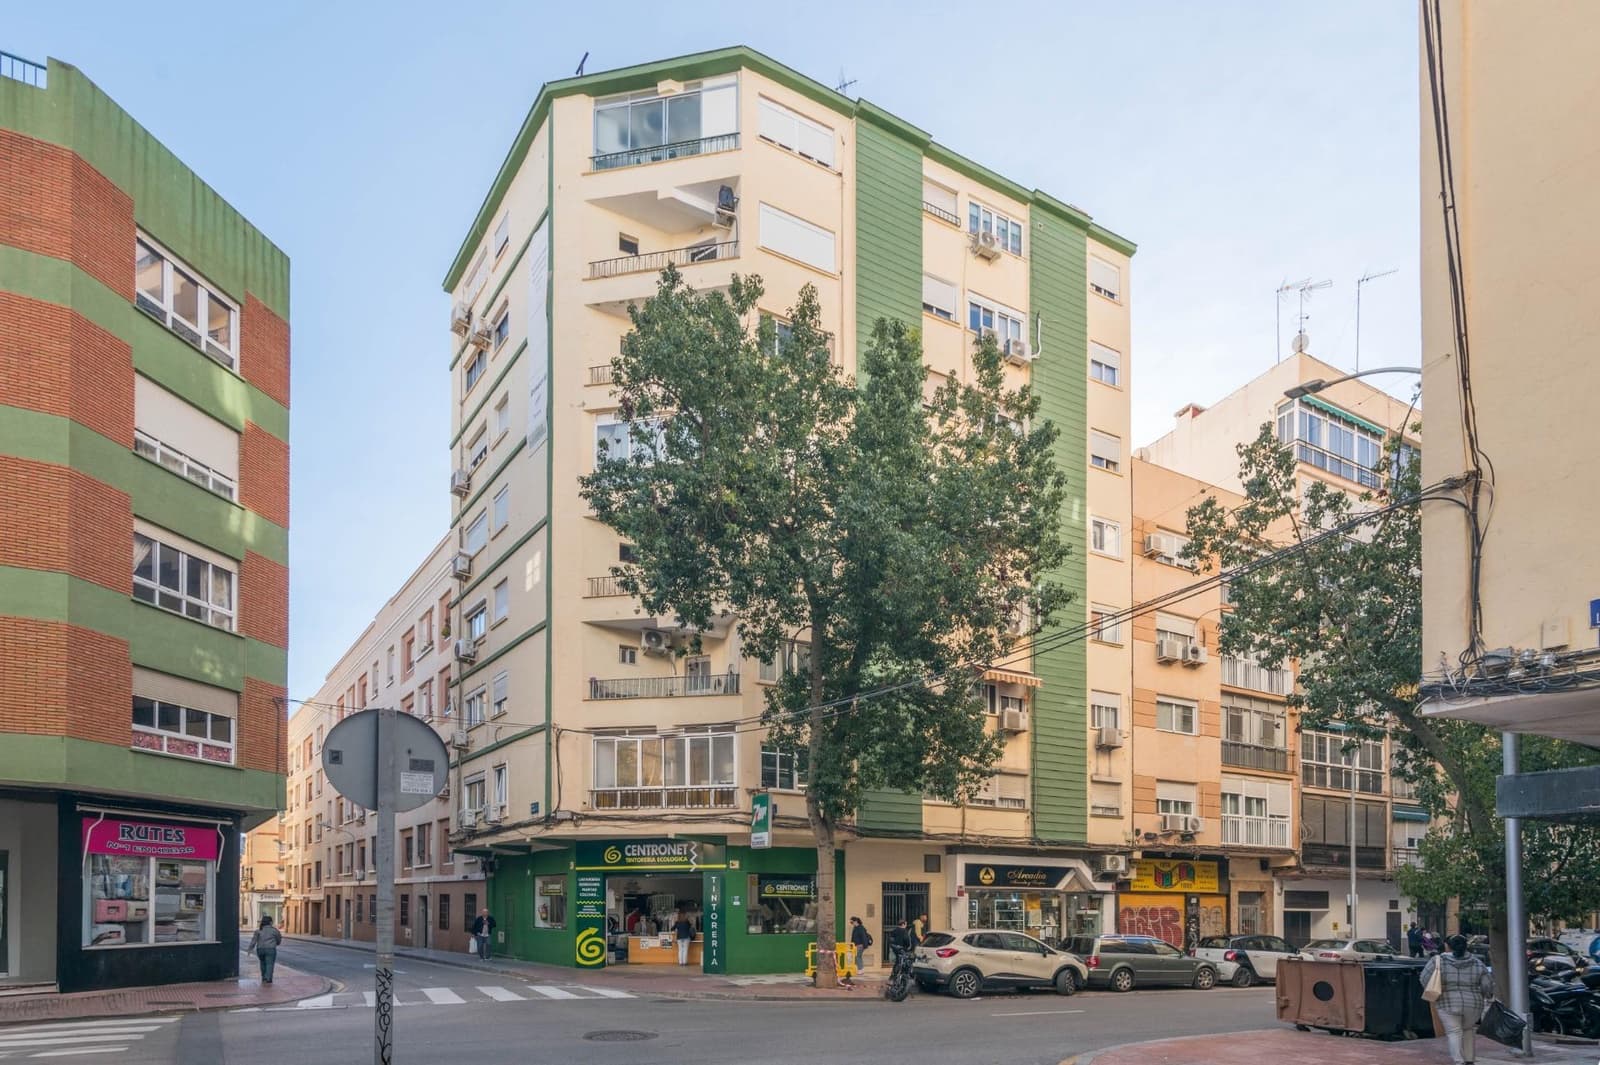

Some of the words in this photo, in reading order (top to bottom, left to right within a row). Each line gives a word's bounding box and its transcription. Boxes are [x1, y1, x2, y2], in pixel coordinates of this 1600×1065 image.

[119, 824, 185, 845] RUTES
[624, 843, 688, 857] CENTRONET
[775, 884, 809, 892] CENTRONET
[711, 876, 719, 966] TINTORERIA
